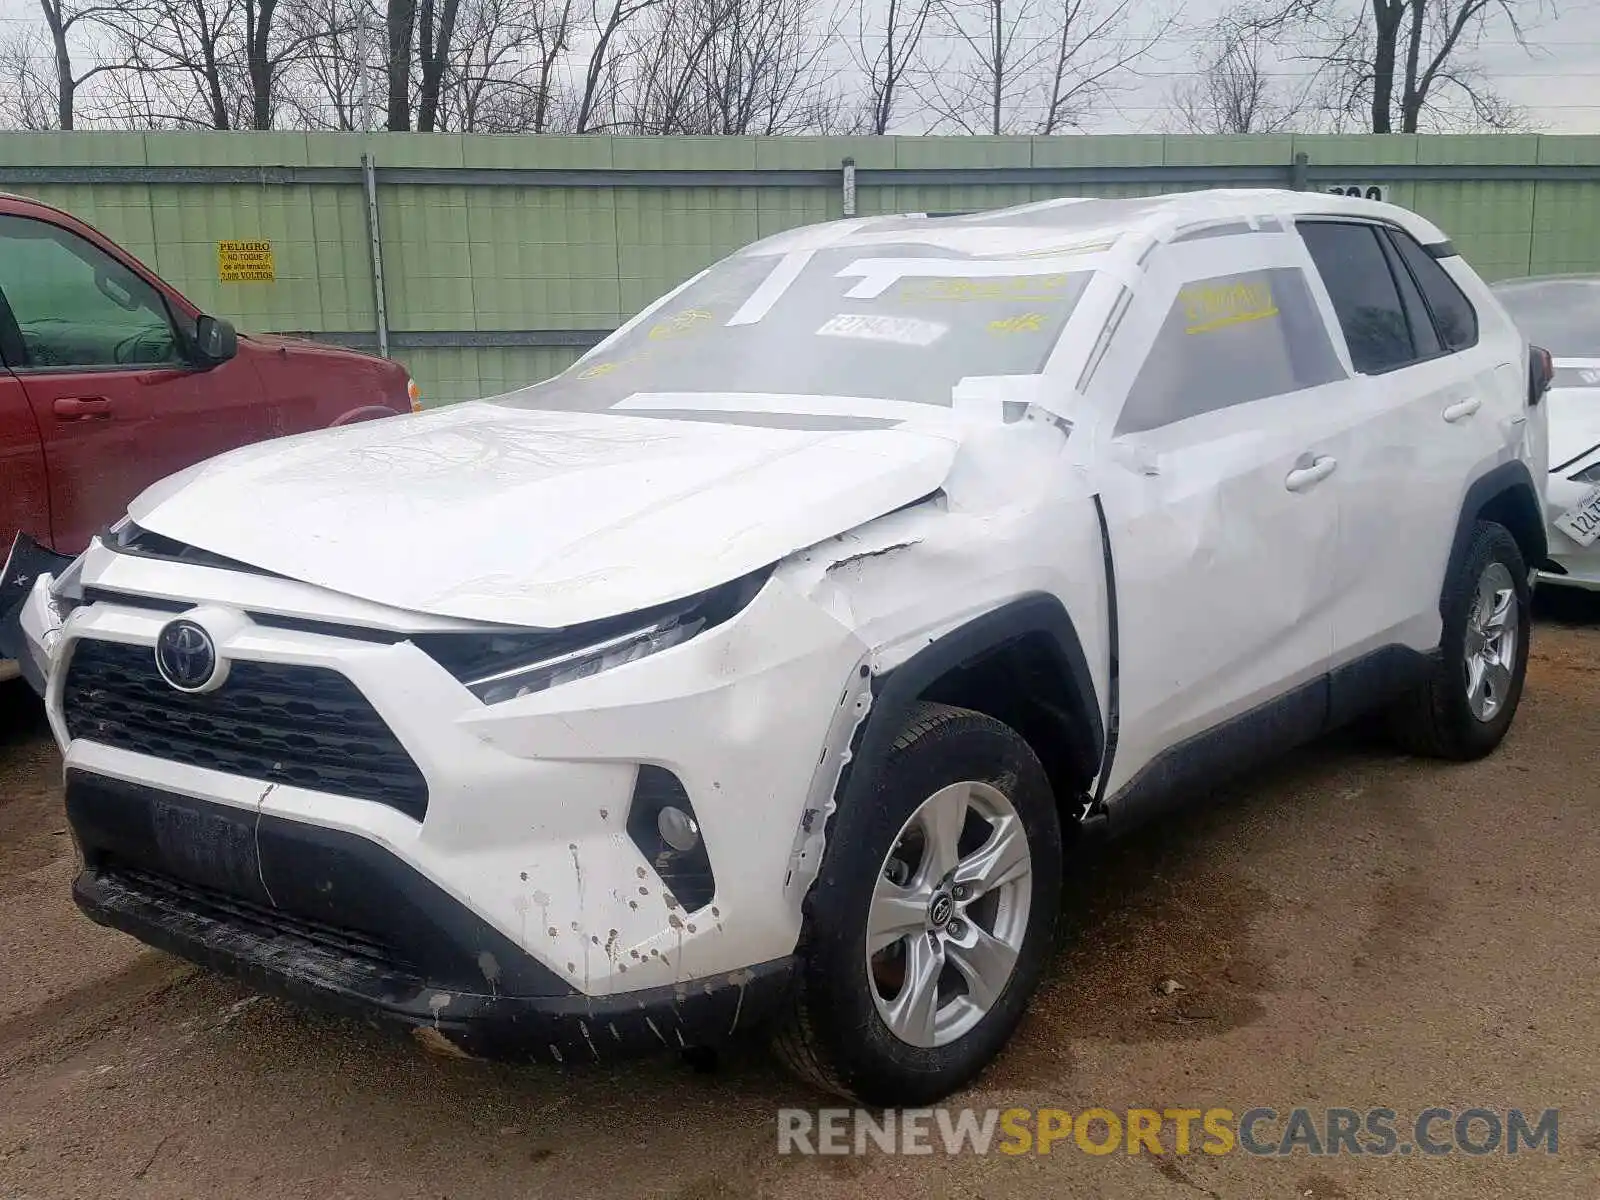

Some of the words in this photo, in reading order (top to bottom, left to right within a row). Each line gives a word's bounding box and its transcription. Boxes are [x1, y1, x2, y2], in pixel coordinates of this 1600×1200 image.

[220, 243, 270, 251] PELIGRO
[228, 253, 238, 261] NO
[240, 253, 264, 261] TOQUE
[241, 271, 273, 279] VOLTIOS
